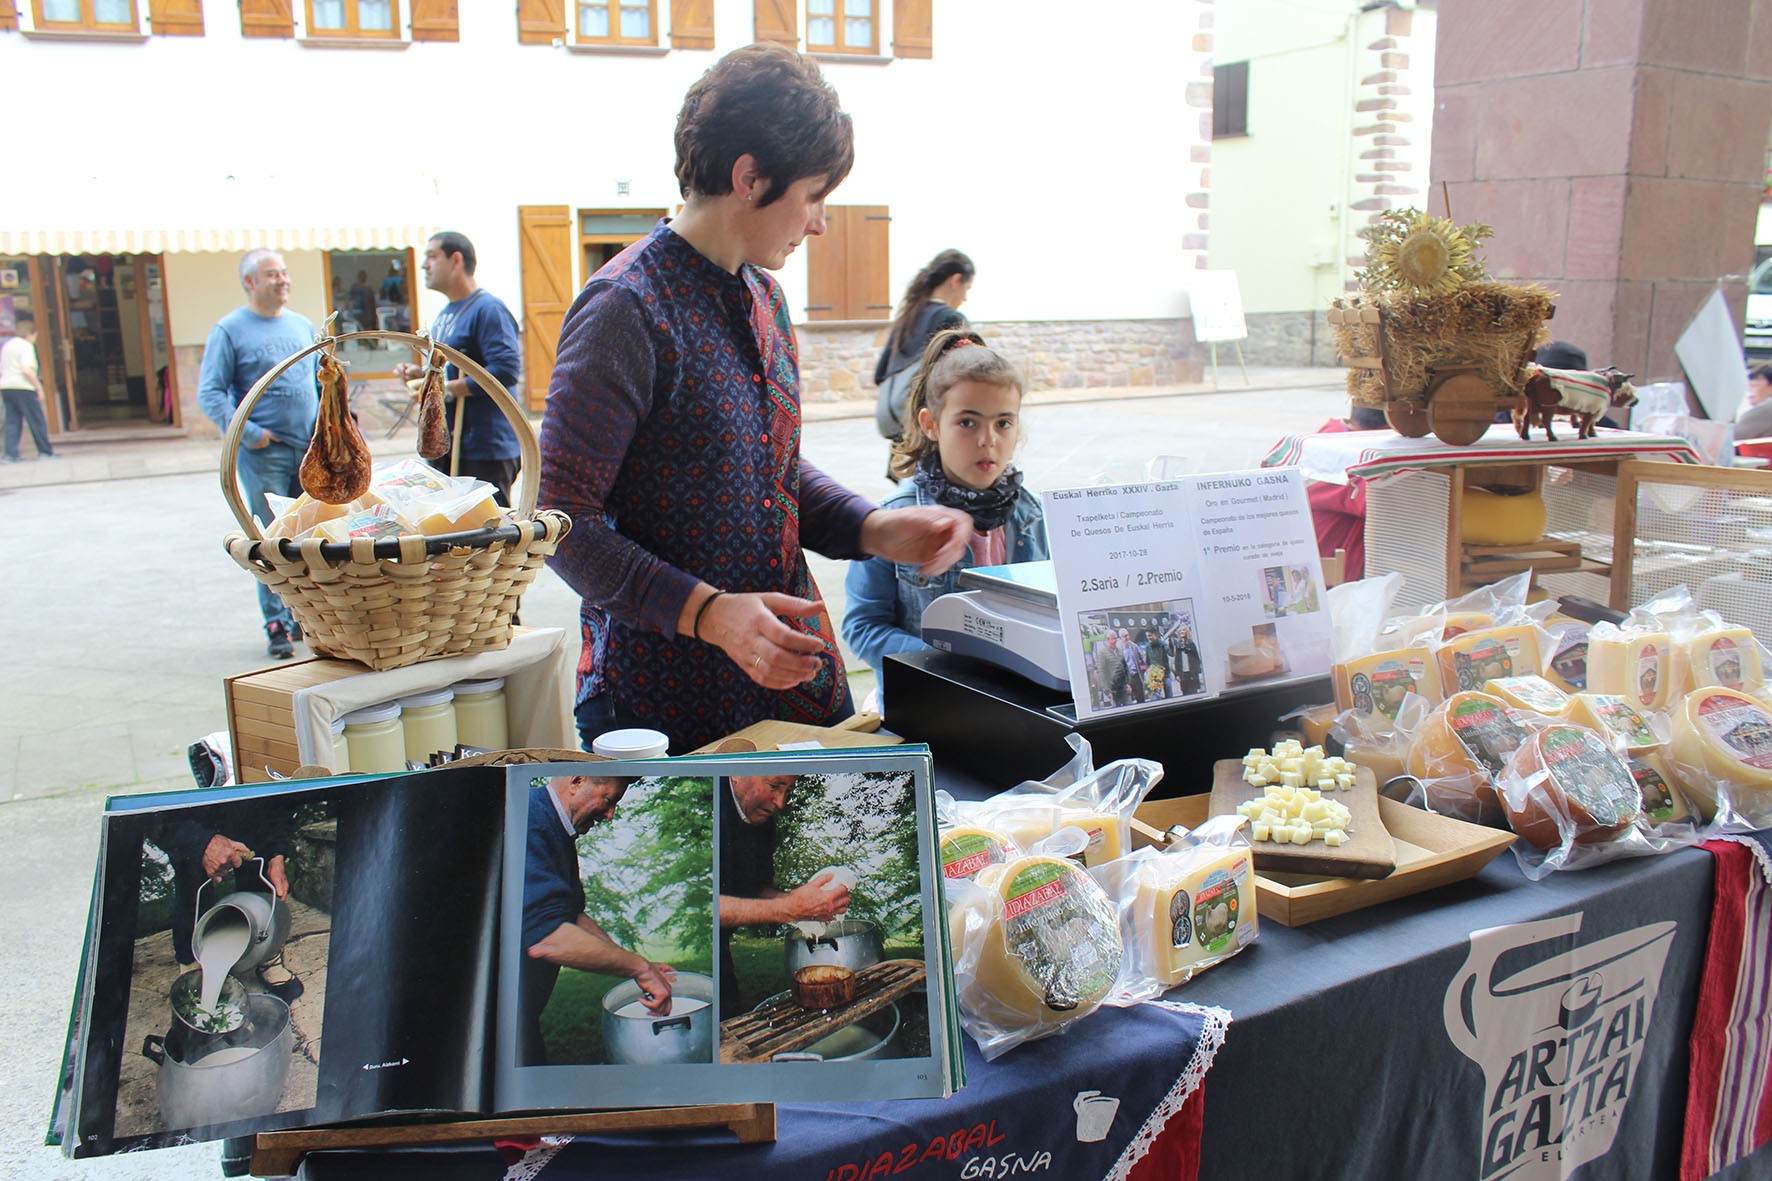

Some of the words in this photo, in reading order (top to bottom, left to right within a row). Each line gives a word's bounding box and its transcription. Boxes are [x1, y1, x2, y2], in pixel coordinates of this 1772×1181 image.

[1053, 490, 1082, 500] Euskal
[1087, 488, 1117, 498] Herriko
[1155, 483, 1179, 493] Gazta
[1197, 478, 1251, 491] INFERNUKO
[1256, 475, 1289, 486] GASNA
[1120, 508, 1164, 520] Campeonato
[1071, 529, 1081, 537] De
[1084, 526, 1111, 537] Quesos
[1114, 524, 1124, 533] De
[1127, 522, 1150, 532] Euskal
[1152, 520, 1174, 529] Herria
[1213, 543, 1241, 554] Premio
[1081, 576, 1119, 592] 2.Saria
[1137, 569, 1183, 586] 2.Premio
[1489, 994, 1645, 1118] ARTZAI
[1541, 1108, 1618, 1162] ELARTEA
[960, 1150, 1052, 1180] GASNA
